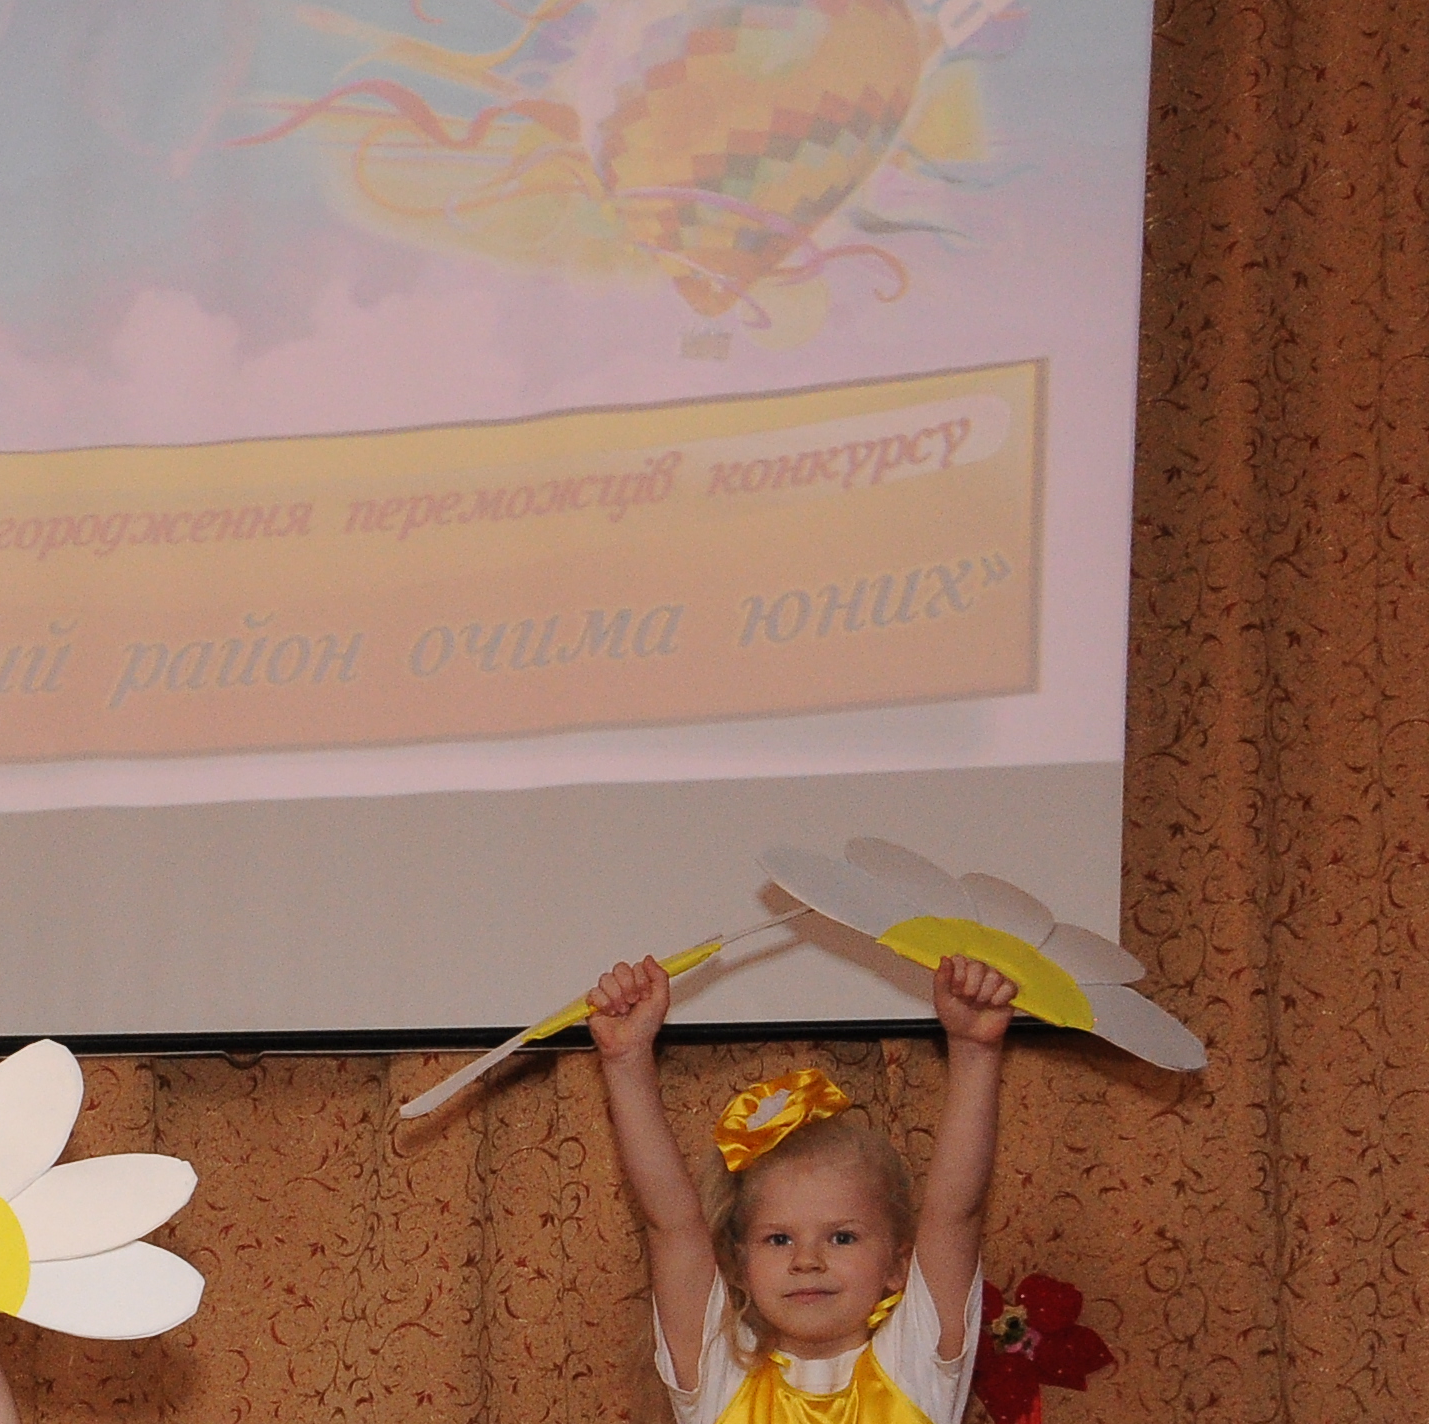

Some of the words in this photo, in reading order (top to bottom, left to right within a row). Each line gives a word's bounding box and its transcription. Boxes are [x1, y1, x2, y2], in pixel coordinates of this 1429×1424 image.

[342, 450, 684, 540] переможців
[706, 416, 972, 498] конкурсу
[107, 611, 365, 711] район
[407, 602, 687, 678] очима
